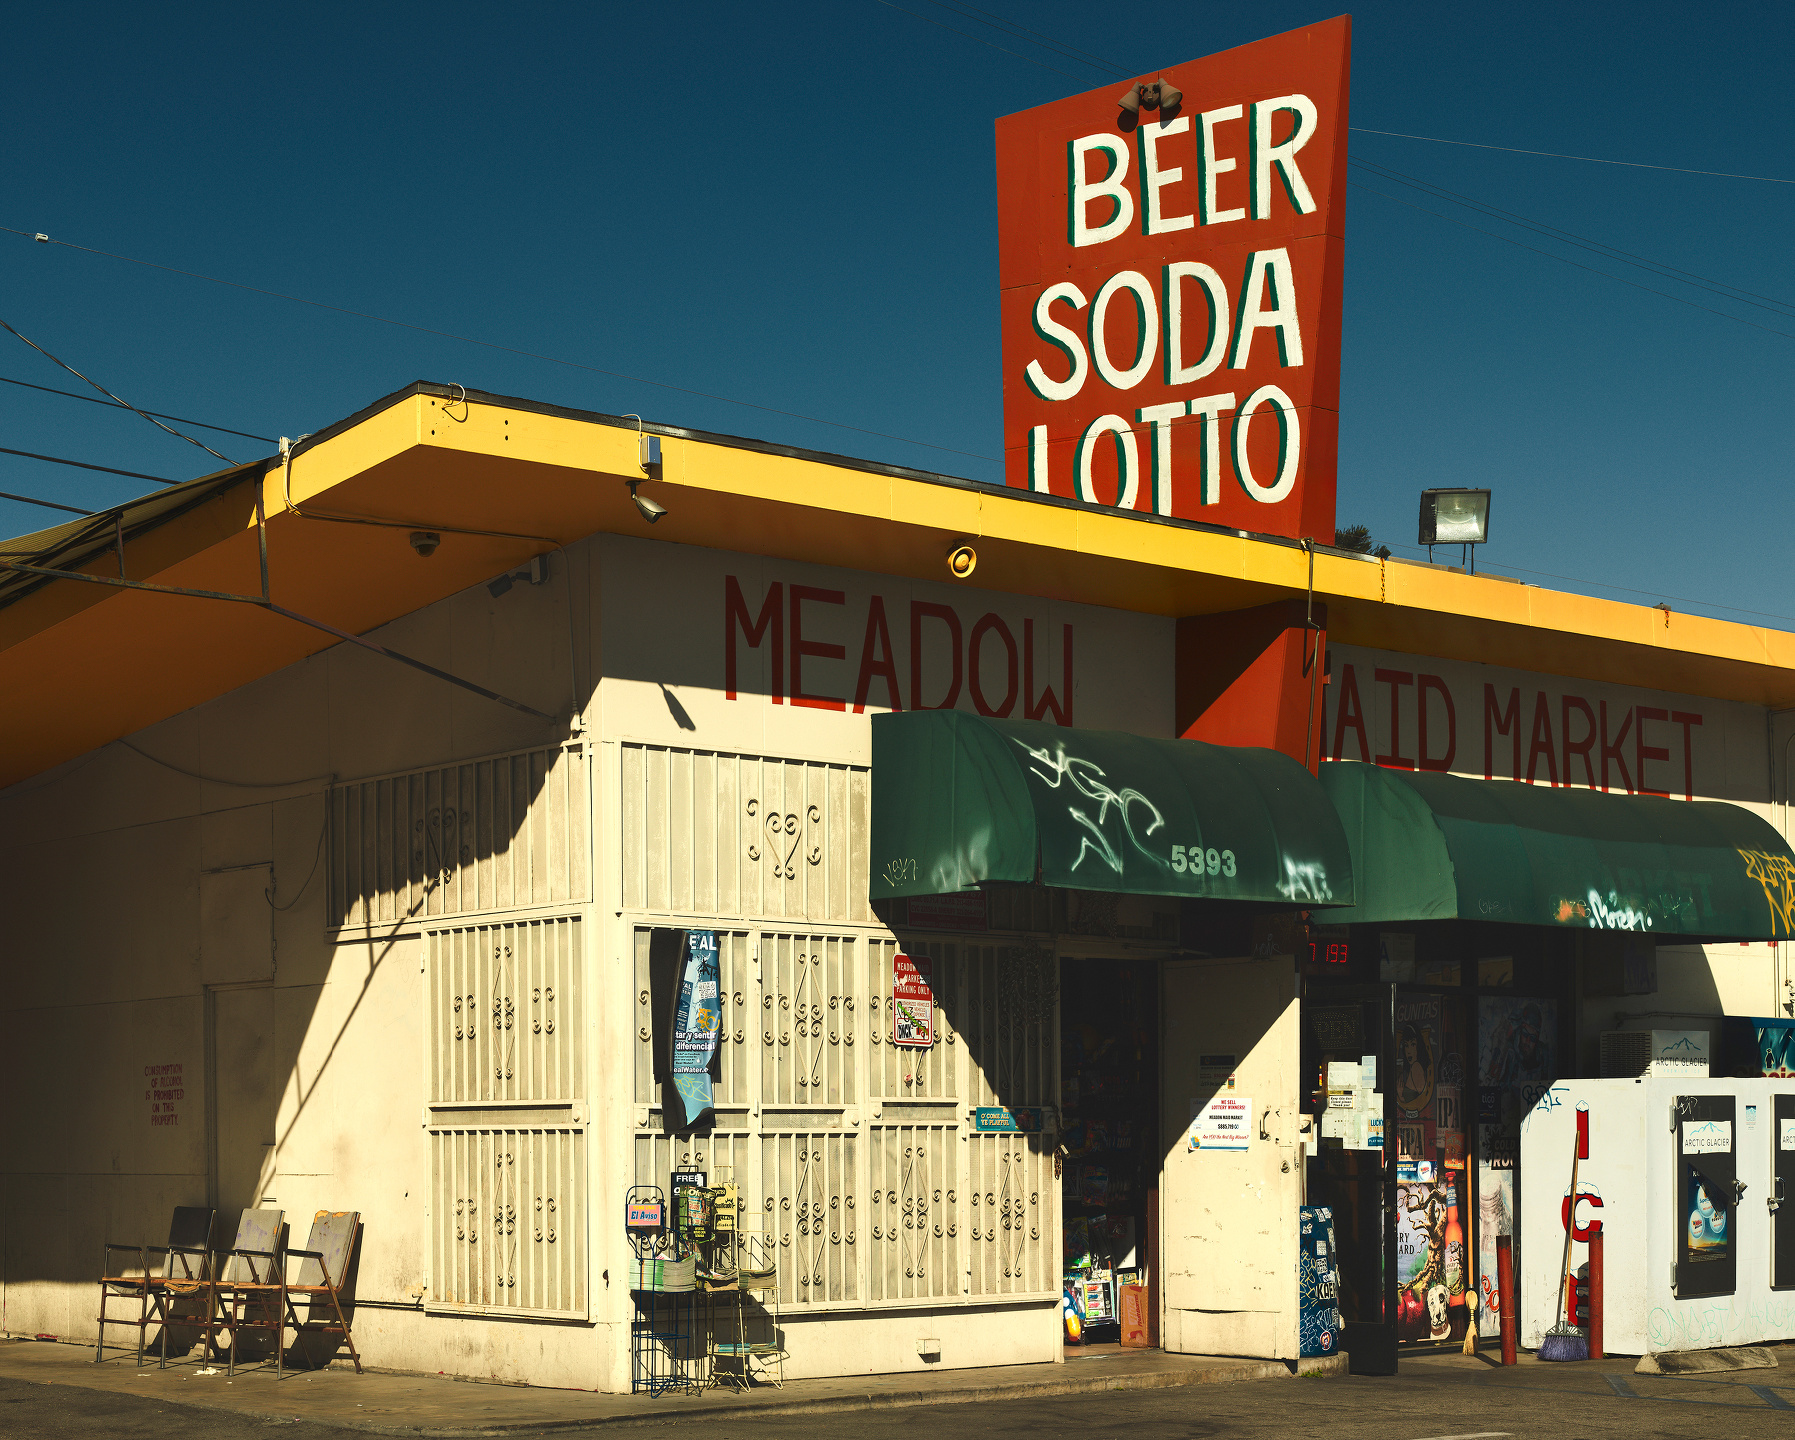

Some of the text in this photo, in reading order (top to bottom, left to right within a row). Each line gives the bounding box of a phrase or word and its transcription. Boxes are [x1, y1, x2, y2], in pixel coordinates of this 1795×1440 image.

[1068, 94, 1317, 247] BEER
[1025, 247, 1303, 400] SODA
[1028, 384, 1300, 516] LOTTO
[725, 575, 1073, 727] MEADOW
[1321, 664, 1702, 801] AID MARKET
[1171, 845, 1237, 877] 5393
[1326, 943, 1349, 964] 193
[897, 962, 917, 972] MEADOW
[896, 984, 929, 995] PARKING ONLY
[687, 1032, 693, 1041] y
[694, 1031, 717, 1039] sentir
[1656, 1057, 1708, 1067] ARCTIC GLACIER
[144, 1063, 183, 1077] CONSUMPTION
[151, 1076, 183, 1088] OF ALCOHOL
[145, 1088, 184, 1101] IS PROHIBITED
[152, 1102, 175, 1113] ON THIS
[1399, 1128, 1424, 1155] IPA
[1494, 1139, 1516, 1151] COLD
[1684, 1138, 1730, 1148] ARCTIC GLACIER
[631, 1211, 658, 1220] El Aviso
